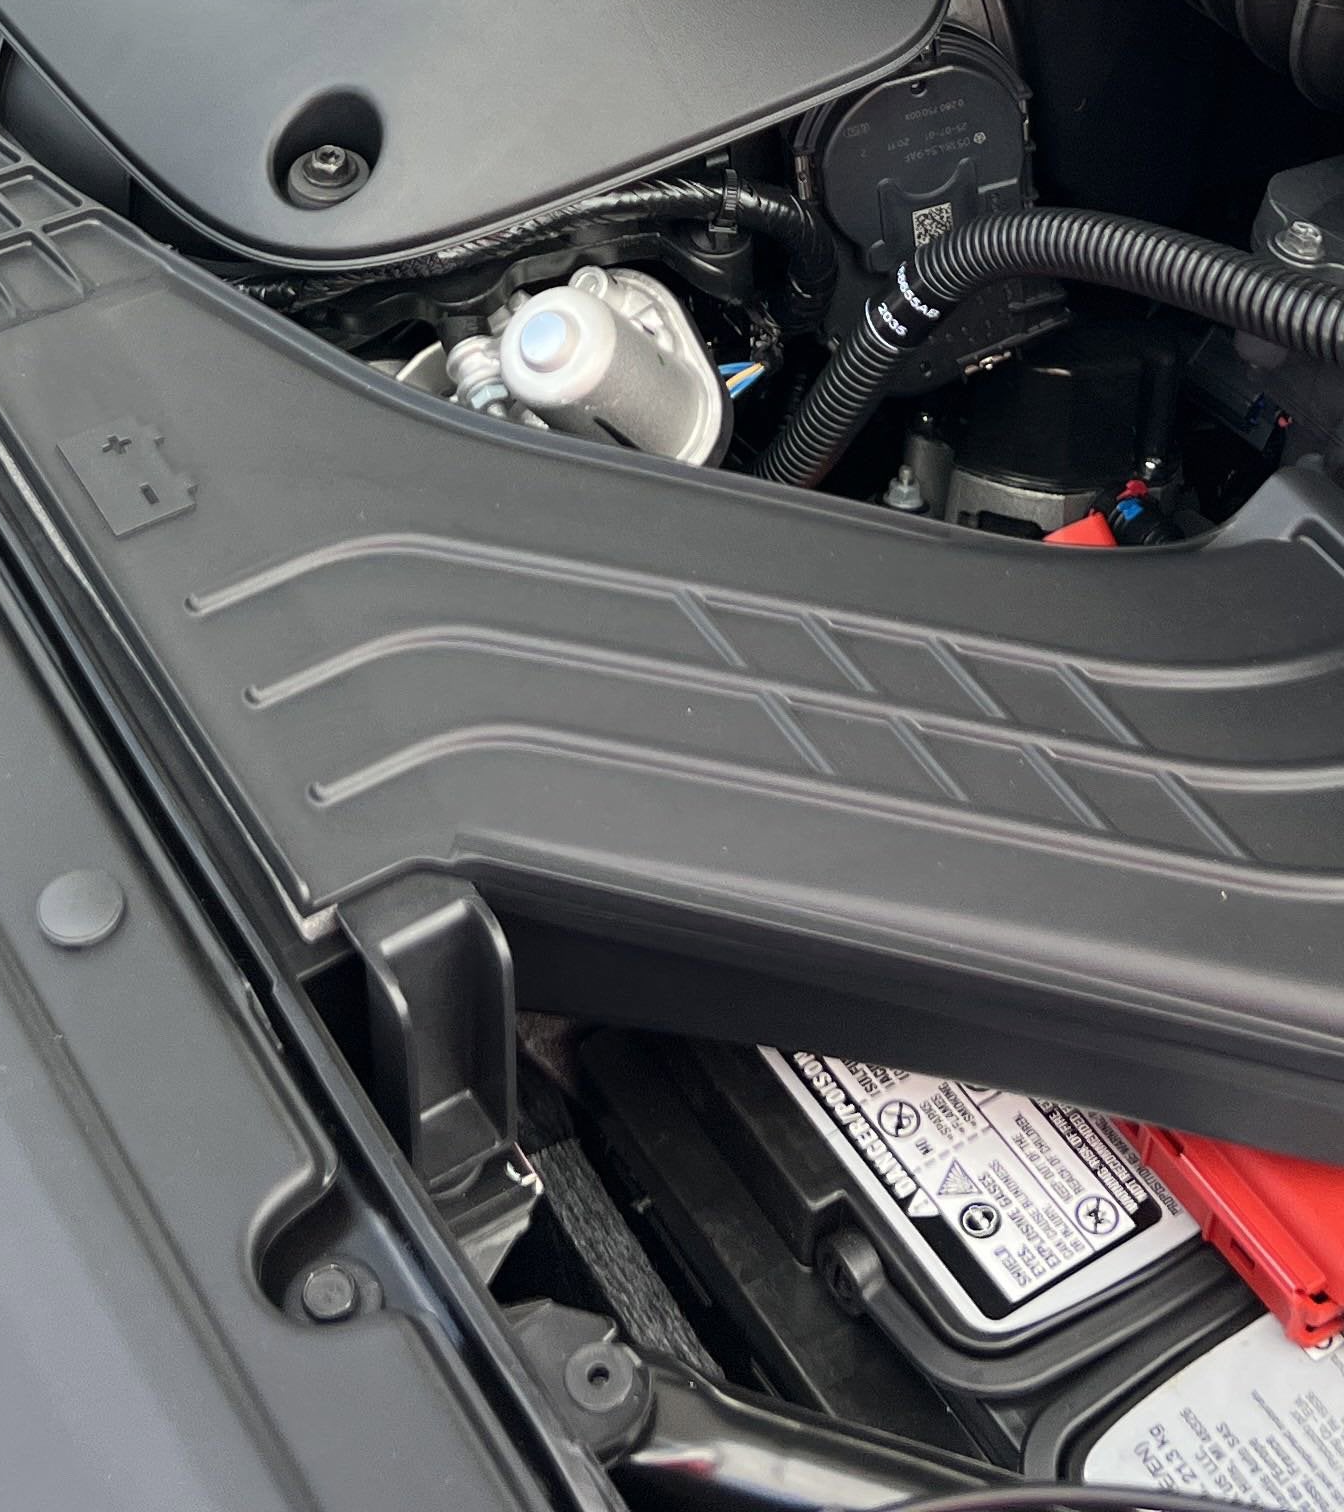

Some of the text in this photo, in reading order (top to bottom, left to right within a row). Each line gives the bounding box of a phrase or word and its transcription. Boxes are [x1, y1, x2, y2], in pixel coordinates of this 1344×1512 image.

[878, 302, 908, 336] 2035
[790, 1043, 919, 1199] DANGER/POISON
[1064, 1128, 1083, 1146] OF
[1074, 1141, 1102, 1168] RISK
[1121, 1175, 1149, 1202] NOT
[975, 1170, 1063, 1270] EXPLOSIVE GASES
[1145, 1420, 1198, 1486] 21.3 kg
